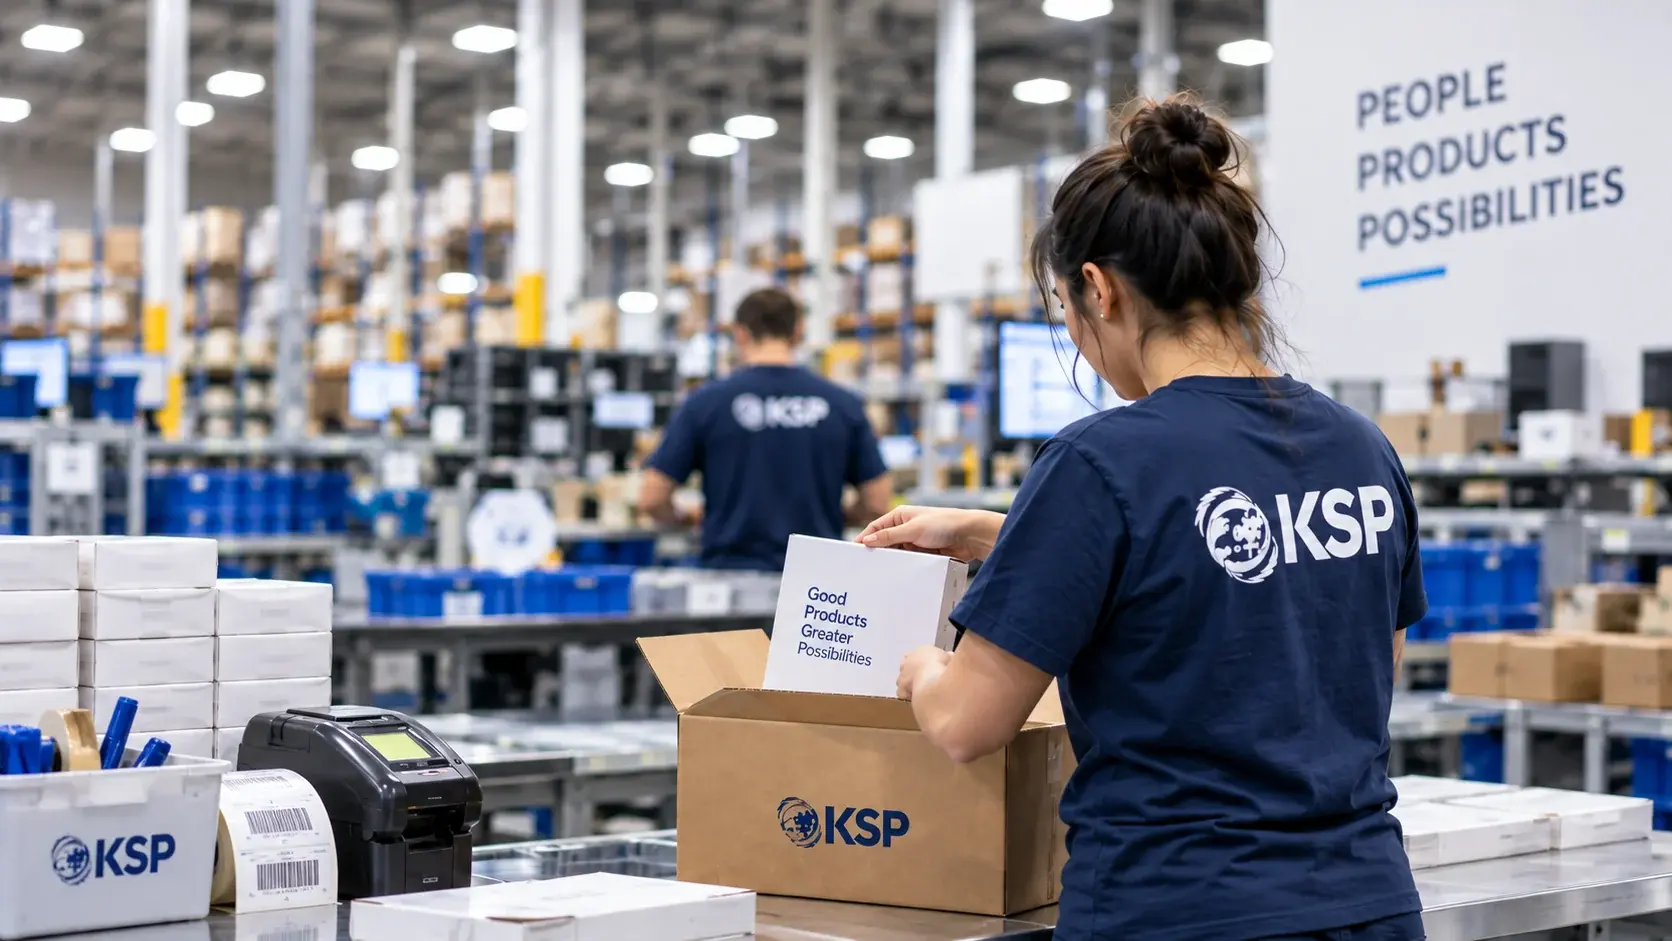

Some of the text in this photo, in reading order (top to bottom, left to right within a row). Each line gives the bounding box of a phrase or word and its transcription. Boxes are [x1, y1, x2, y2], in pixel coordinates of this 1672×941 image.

[1357, 62, 1507, 131] PEOPLE
[1357, 114, 1567, 191] PRODUCTS
[1357, 166, 1625, 252] POSSIBILITIES
[1275, 485, 1395, 564] KSP
[804, 604, 868, 628] Products
[807, 586, 848, 606] Good
[797, 641, 872, 667] Possibilities
[801, 623, 854, 645] Greater
[825, 806, 910, 848] KSP
[95, 834, 176, 878] KSP
